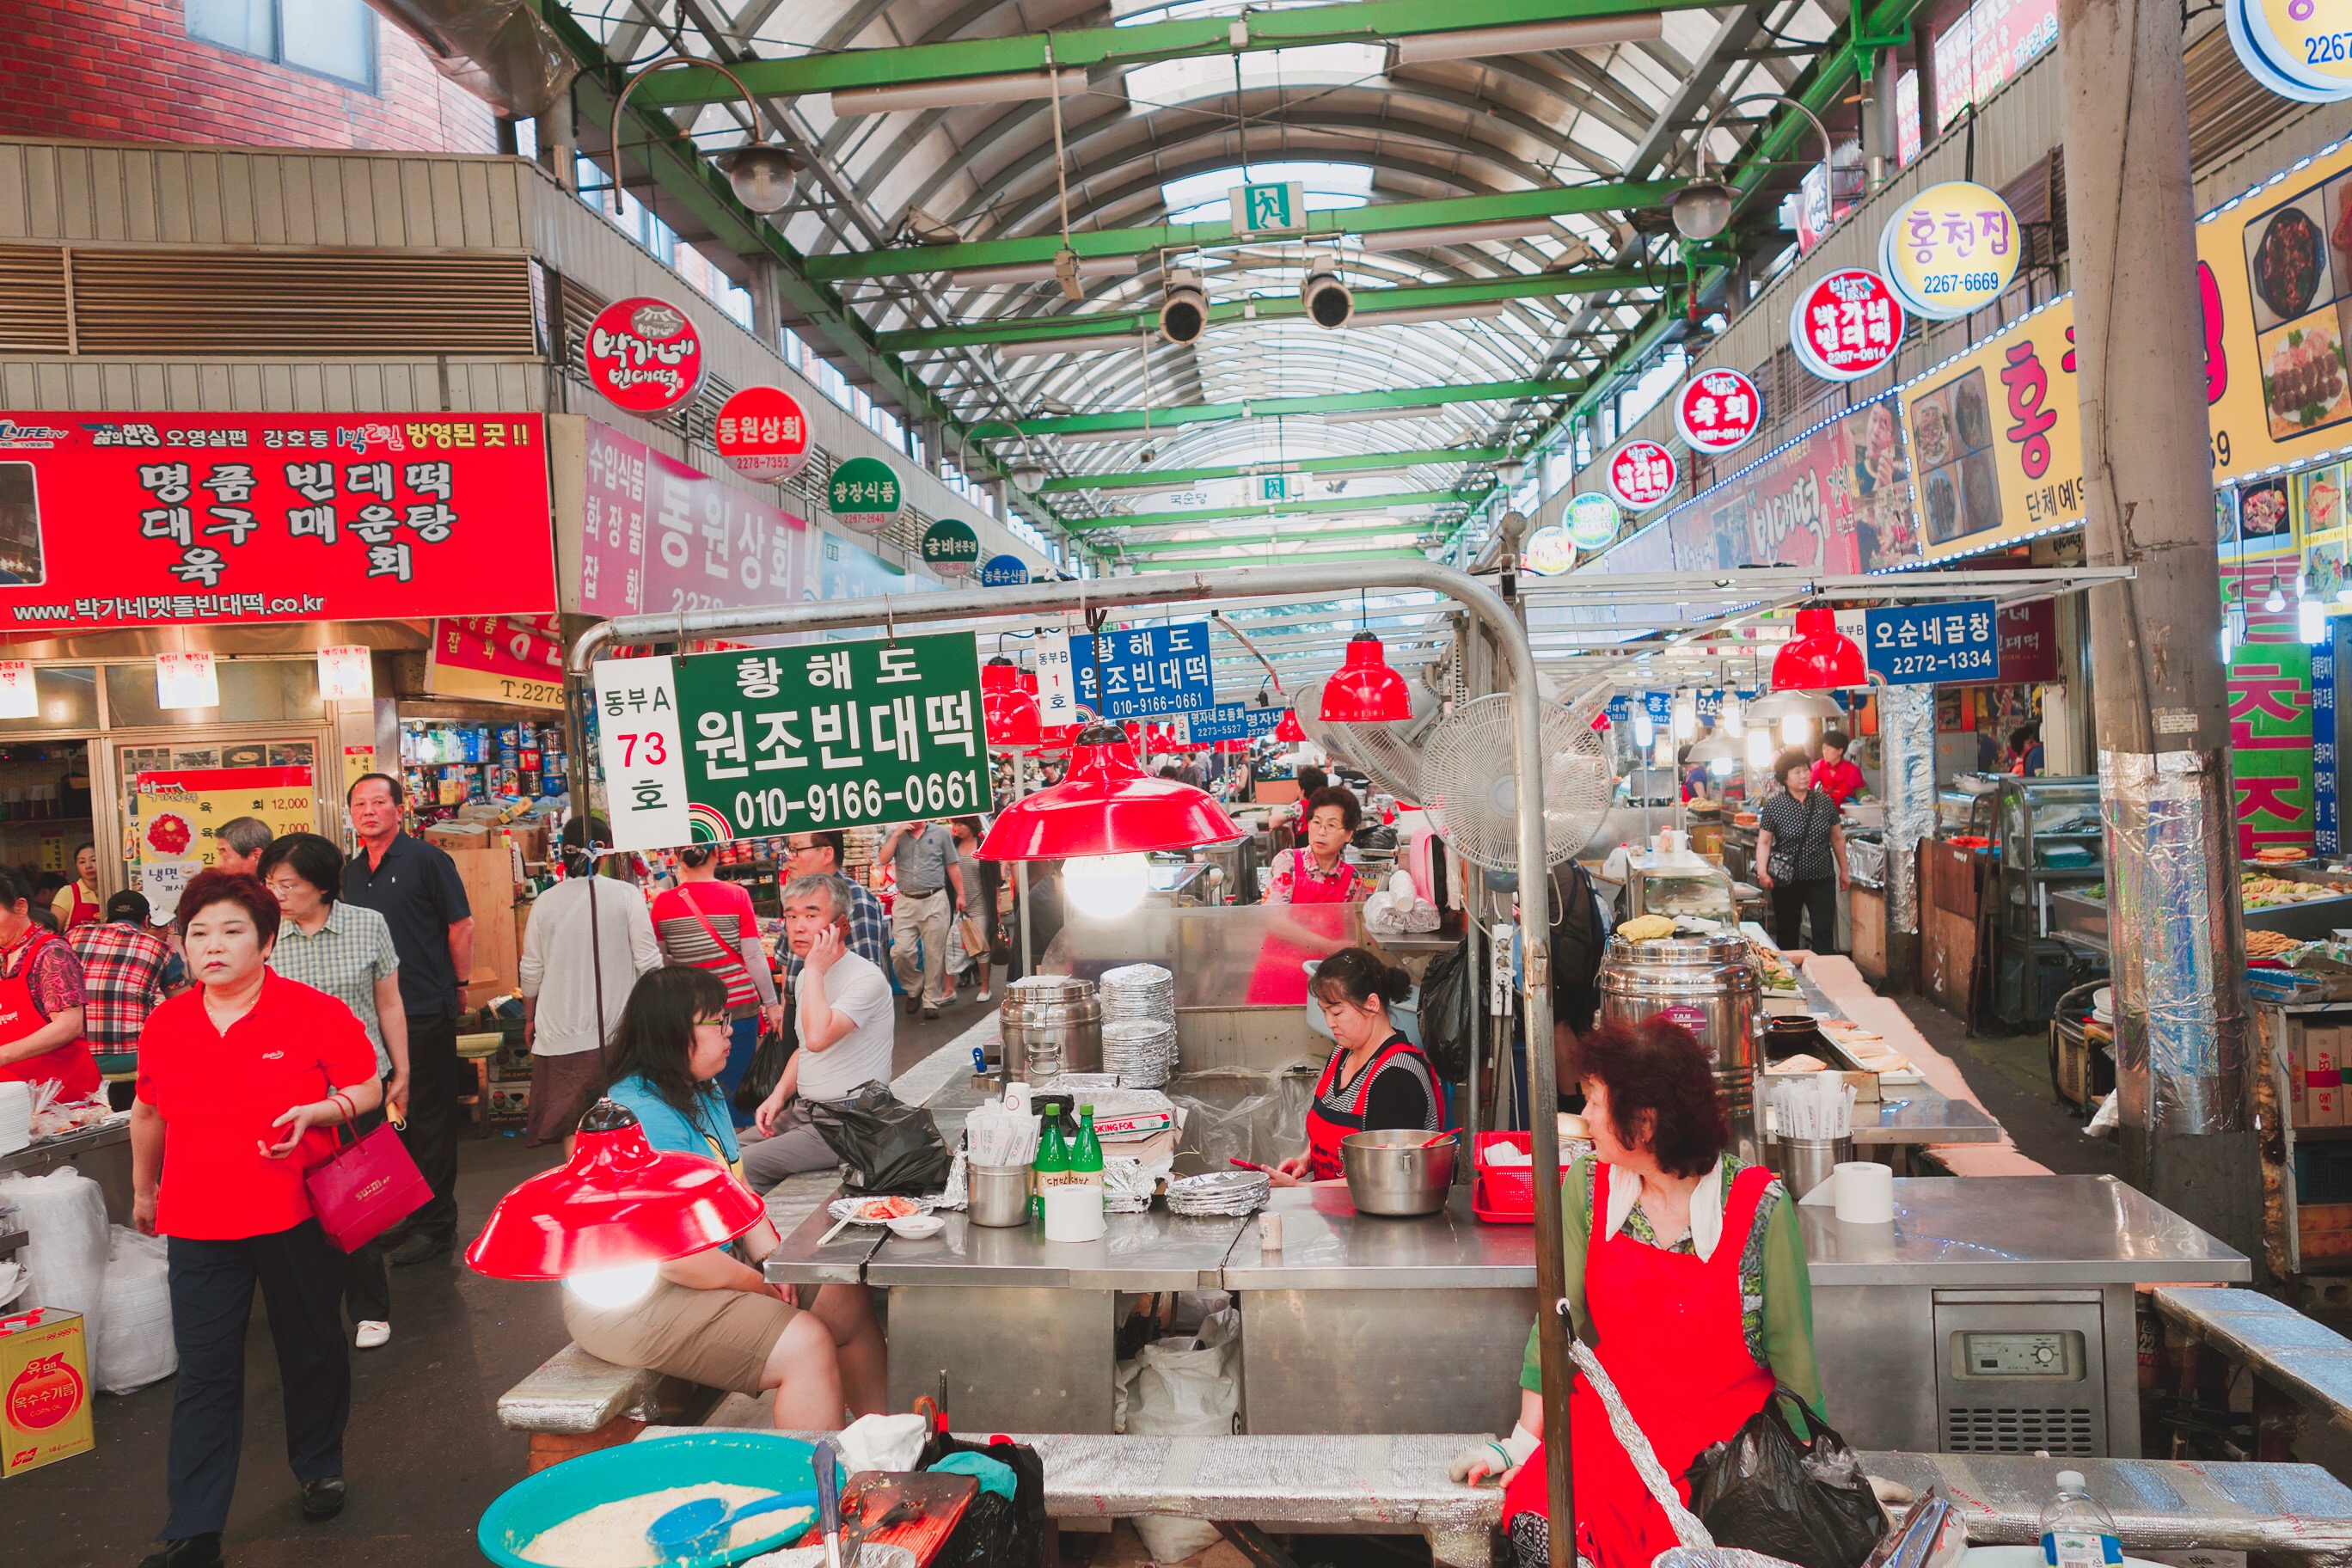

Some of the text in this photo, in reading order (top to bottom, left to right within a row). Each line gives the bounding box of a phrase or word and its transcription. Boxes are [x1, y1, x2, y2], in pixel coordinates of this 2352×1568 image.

[1907, 210, 2009, 264] 홍천집
[1924, 273, 1999, 294] 2267-6669
[1813, 297, 1890, 326] 박가네
[592, 327, 695, 368] 박가네
[1815, 322, 1891, 352] 빈대떡
[1827, 346, 1887, 365] 2267-0614
[609, 368, 678, 398] 빈대떡
[1689, 393, 1749, 427] 육회
[166, 430, 248, 447] 오영실편
[263, 429, 329, 449] 강호동
[406, 421, 476, 449] 방영된
[481, 423, 506, 447] 곳
[719, 415, 802, 444] 동원상회
[590, 438, 644, 503] 수입식품
[737, 456, 789, 469] 2278-7352
[137, 459, 454, 505] 명품 빈대떡
[833, 481, 896, 504] 광장식품
[1170, 493, 1207, 505] 국순당
[139, 503, 459, 547] 대구 매운탕
[585, 494, 642, 555] 화장품
[658, 475, 793, 600] 동원상회
[984, 568, 1027, 585] 농축수산물
[1875, 612, 1990, 648] 오순네곱창
[1091, 628, 1193, 663] 황해도
[736, 647, 922, 699] 황해도
[1893, 649, 1992, 675] 2272-1334
[1051, 674, 1059, 687] 1
[1079, 654, 1209, 700] 원조빈대떡
[1050, 694, 1067, 709] 호
[1112, 692, 1203, 715] 010-9166-0661
[1179, 719, 1185, 729] 5
[1197, 725, 1241, 738] 2273-5527
[1246, 710, 1284, 726] 명자네
[695, 689, 976, 781] 원조빈대떡
[616, 731, 668, 769] 73
[272, 798, 309, 810] 12,000
[632, 779, 668, 812] 호
[734, 769, 978, 830] 010-9166-0661
[149, 867, 180, 882] 냉면
[1093, 1121, 1136, 1133] OKING FOIL
[15, 1382, 75, 1409] 옥수수기름
